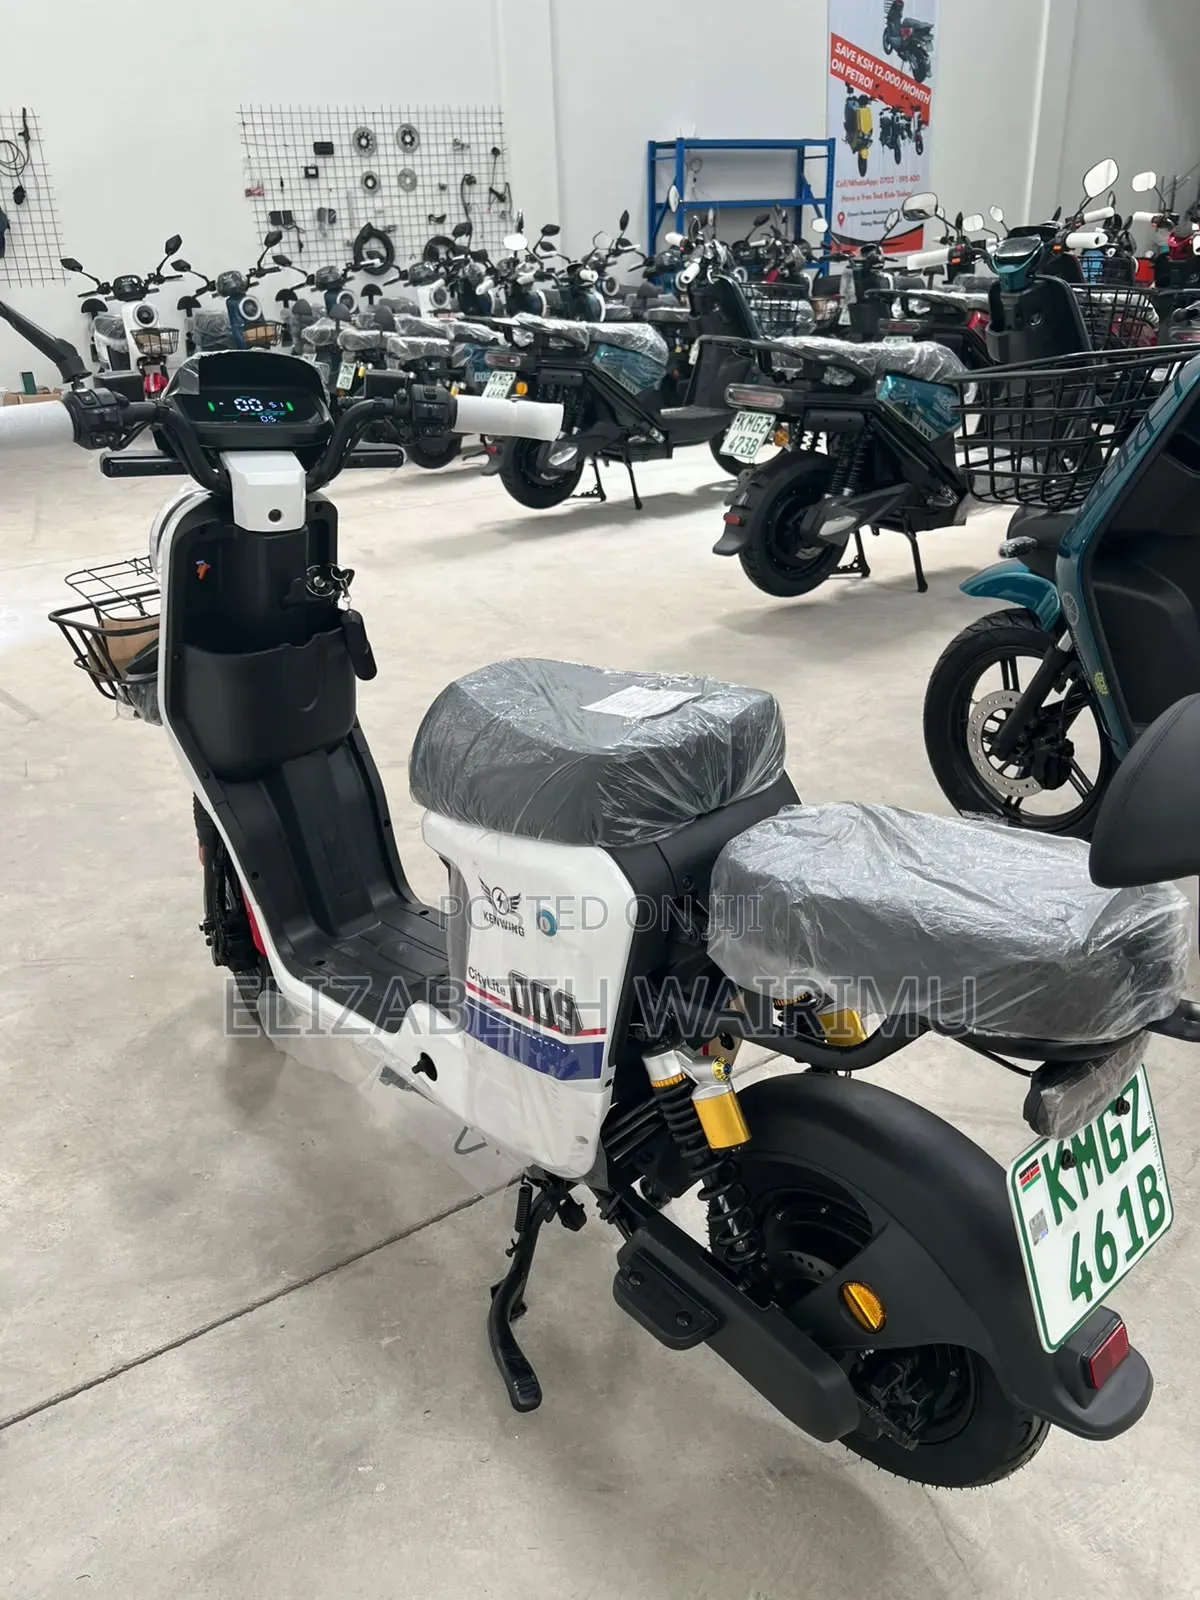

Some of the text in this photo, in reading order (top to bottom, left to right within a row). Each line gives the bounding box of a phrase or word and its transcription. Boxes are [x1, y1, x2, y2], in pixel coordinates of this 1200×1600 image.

[831, 58, 845, 73] ON
[835, 42, 931, 104] SAVE KSH 12,000/MONTH
[233, 398, 263, 412] 00
[736, 413, 772, 434] KMGZ
[728, 435, 760, 455] 473B
[482, 910, 525, 938] KENWING
[468, 966, 507, 997] CityLite
[1041, 1073, 1151, 1227] KMGZ
[1069, 1164, 1166, 1303] 461B
